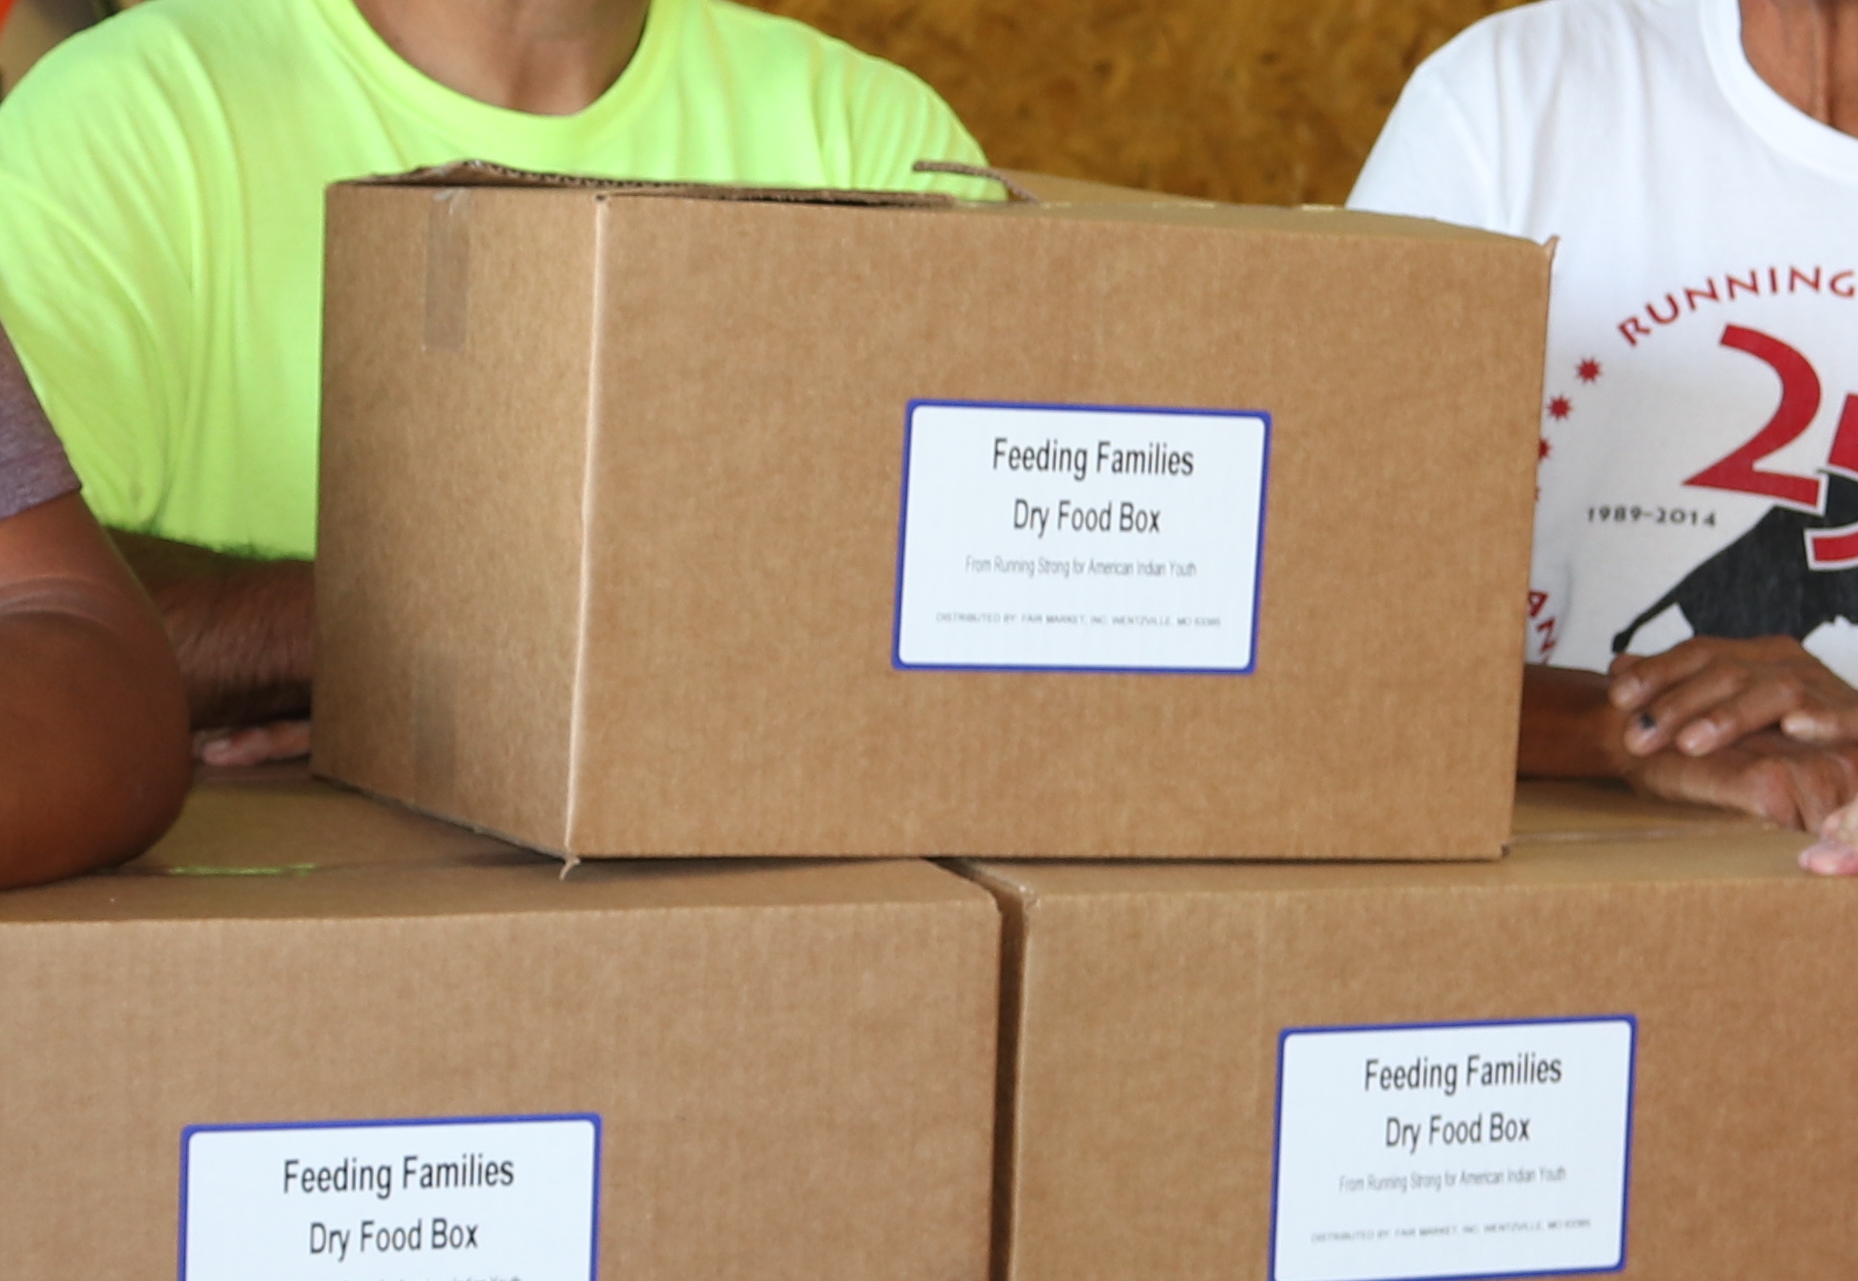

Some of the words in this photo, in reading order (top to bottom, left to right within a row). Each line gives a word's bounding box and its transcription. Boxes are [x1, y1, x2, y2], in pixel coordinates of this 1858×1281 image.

[1616, 265, 1857, 347] RUNNING
[993, 437, 1087, 482] Feeding
[1097, 441, 1194, 476] Families
[1014, 498, 1049, 539] Dry
[1058, 499, 1112, 532] Food
[1119, 501, 1160, 533] Box
[1588, 505, 1717, 527] 1989-2014
[1365, 1057, 1458, 1095] Feeding
[1466, 1053, 1562, 1086] Families
[1386, 1117, 1421, 1155] Dry
[1429, 1113, 1482, 1145] Food
[1489, 1112, 1529, 1142] Box
[284, 1158, 392, 1200] Feeding
[403, 1154, 514, 1189] Families
[310, 1222, 350, 1262] Dry
[360, 1219, 422, 1252] Food
[431, 1217, 478, 1249] Box
